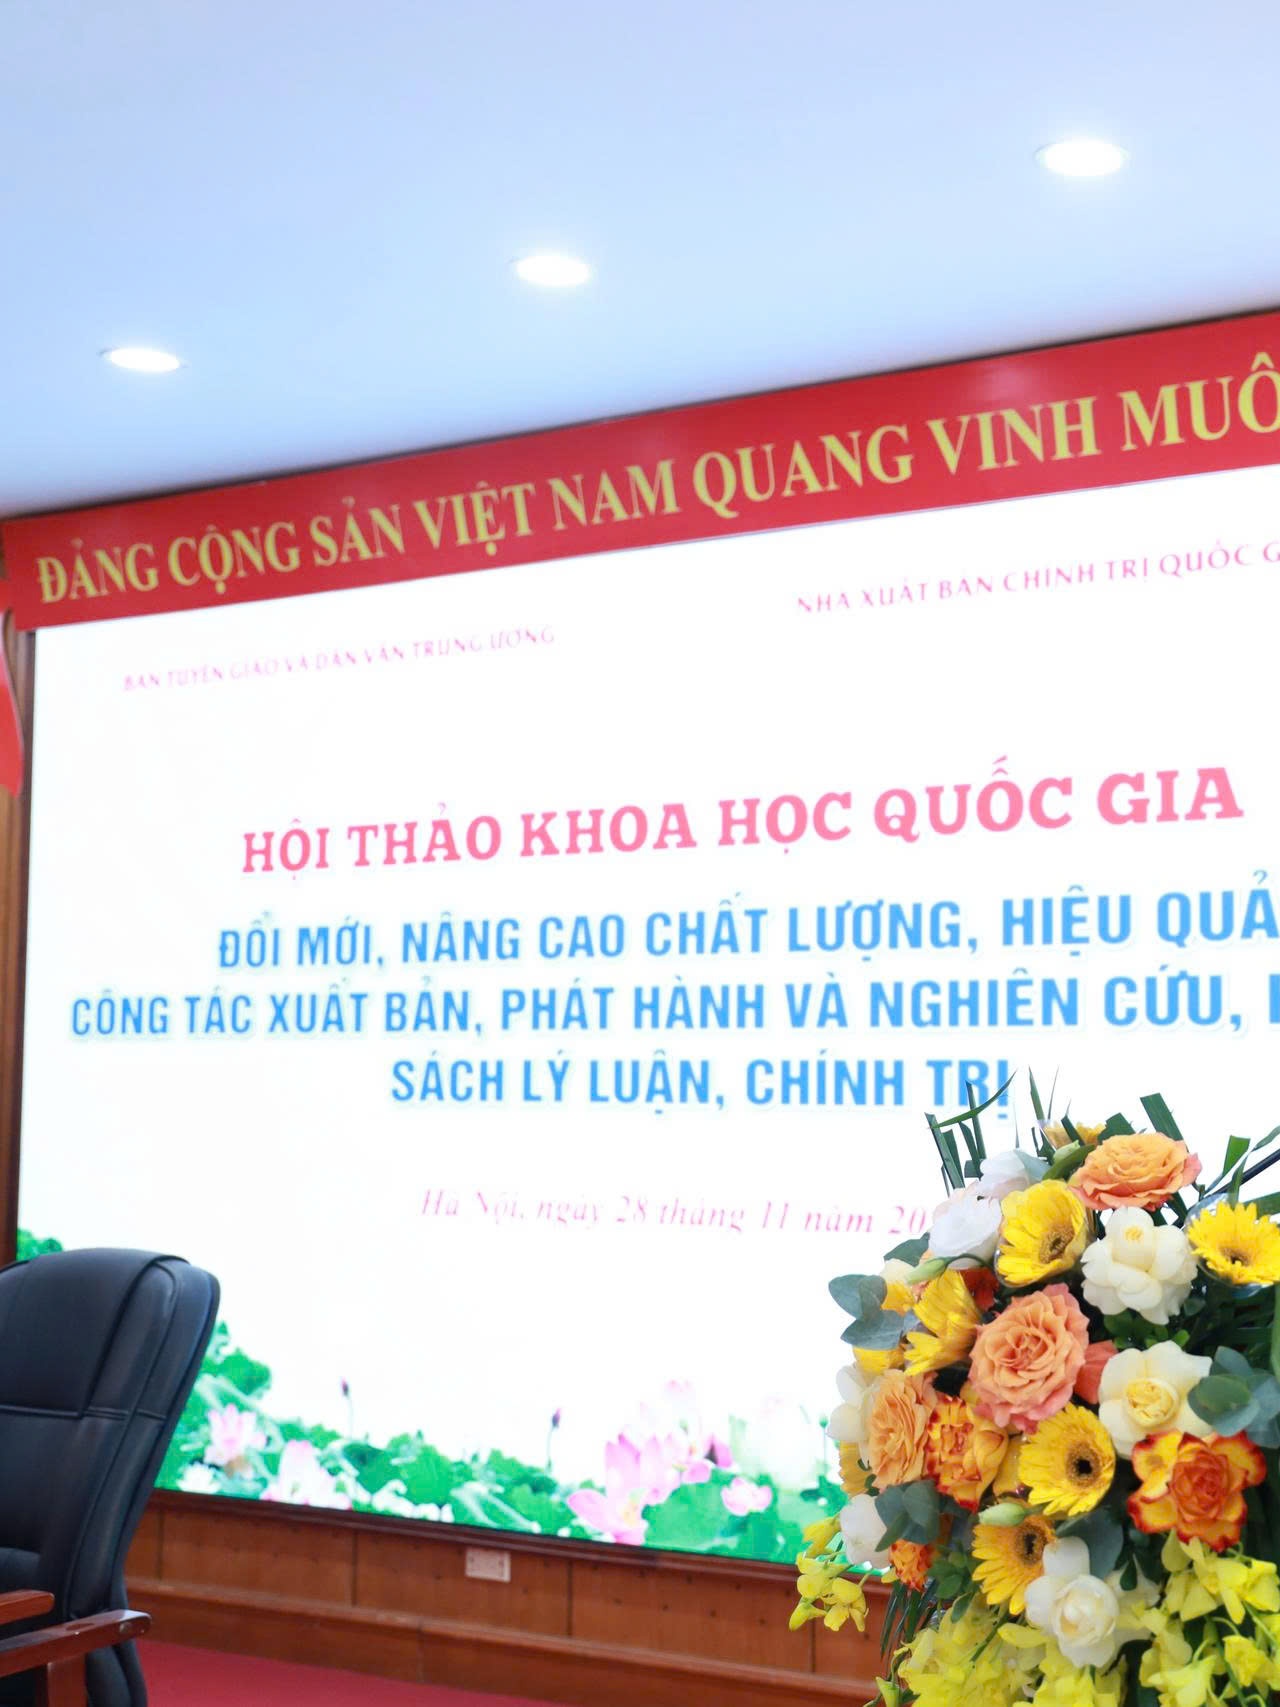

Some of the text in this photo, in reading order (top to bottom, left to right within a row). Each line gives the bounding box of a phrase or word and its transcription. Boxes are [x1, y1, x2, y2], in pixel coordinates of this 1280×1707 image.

[37, 540, 158, 601] ĐẢNG
[168, 524, 299, 593] CỘNG
[311, 498, 405, 564] SẢN
[414, 481, 535, 555] VIỆT
[551, 460, 681, 531] NAM
[693, 426, 914, 518] QUANG
[927, 397, 1101, 471] VINH
[241, 757, 1243, 881] HỘI THẢO KHOA HỌC QUỐC GIA
[219, 871, 1279, 968] ĐỔI MỚI, NÂNG CAO CHẤT LƯỢNG, HIỆU QUẢ
[72, 990, 169, 1037] CÔNG
[184, 986, 253, 1035] TÁC
[268, 976, 368, 1034] XUẤT
[385, 977, 482, 1035] BẢN,
[501, 978, 614, 1030] PHÁT
[634, 976, 764, 1029] HÀNH
[785, 972, 848, 1028] VÀ
[869, 967, 1078, 1028] NGHIÊN
[1104, 965, 1241, 1031] CỨU,
[392, 1050, 1008, 1119] SÁCH LÝ LUẬN, CHÍNH TRỊ
[616, 1196, 648, 1223] 28
[762, 1201, 789, 1229] 11
